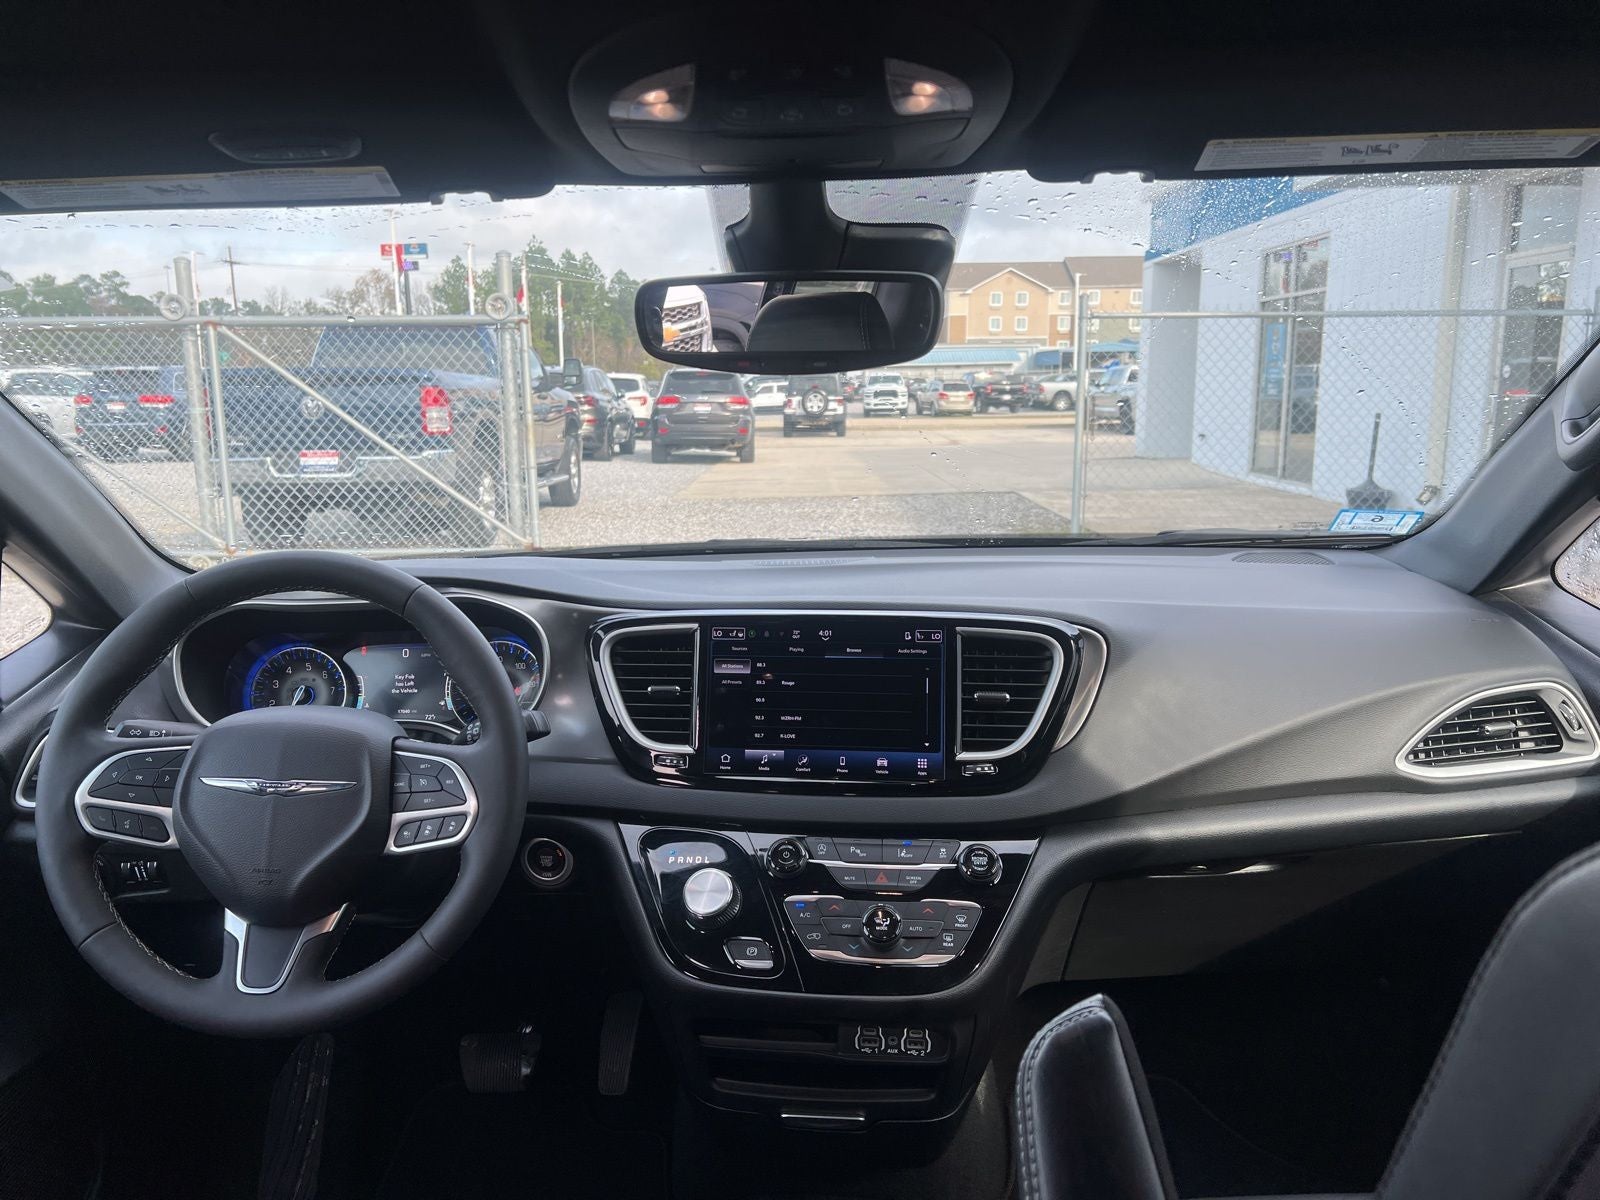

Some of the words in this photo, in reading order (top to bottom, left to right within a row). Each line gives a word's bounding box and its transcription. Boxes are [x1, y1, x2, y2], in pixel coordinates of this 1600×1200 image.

[818, 629, 832, 638] 4:01
[286, 666, 292, 674] 4
[305, 662, 312, 671] 5
[322, 671, 328, 679] 6
[272, 680, 279, 689] 3
[330, 686, 335, 695] 7
